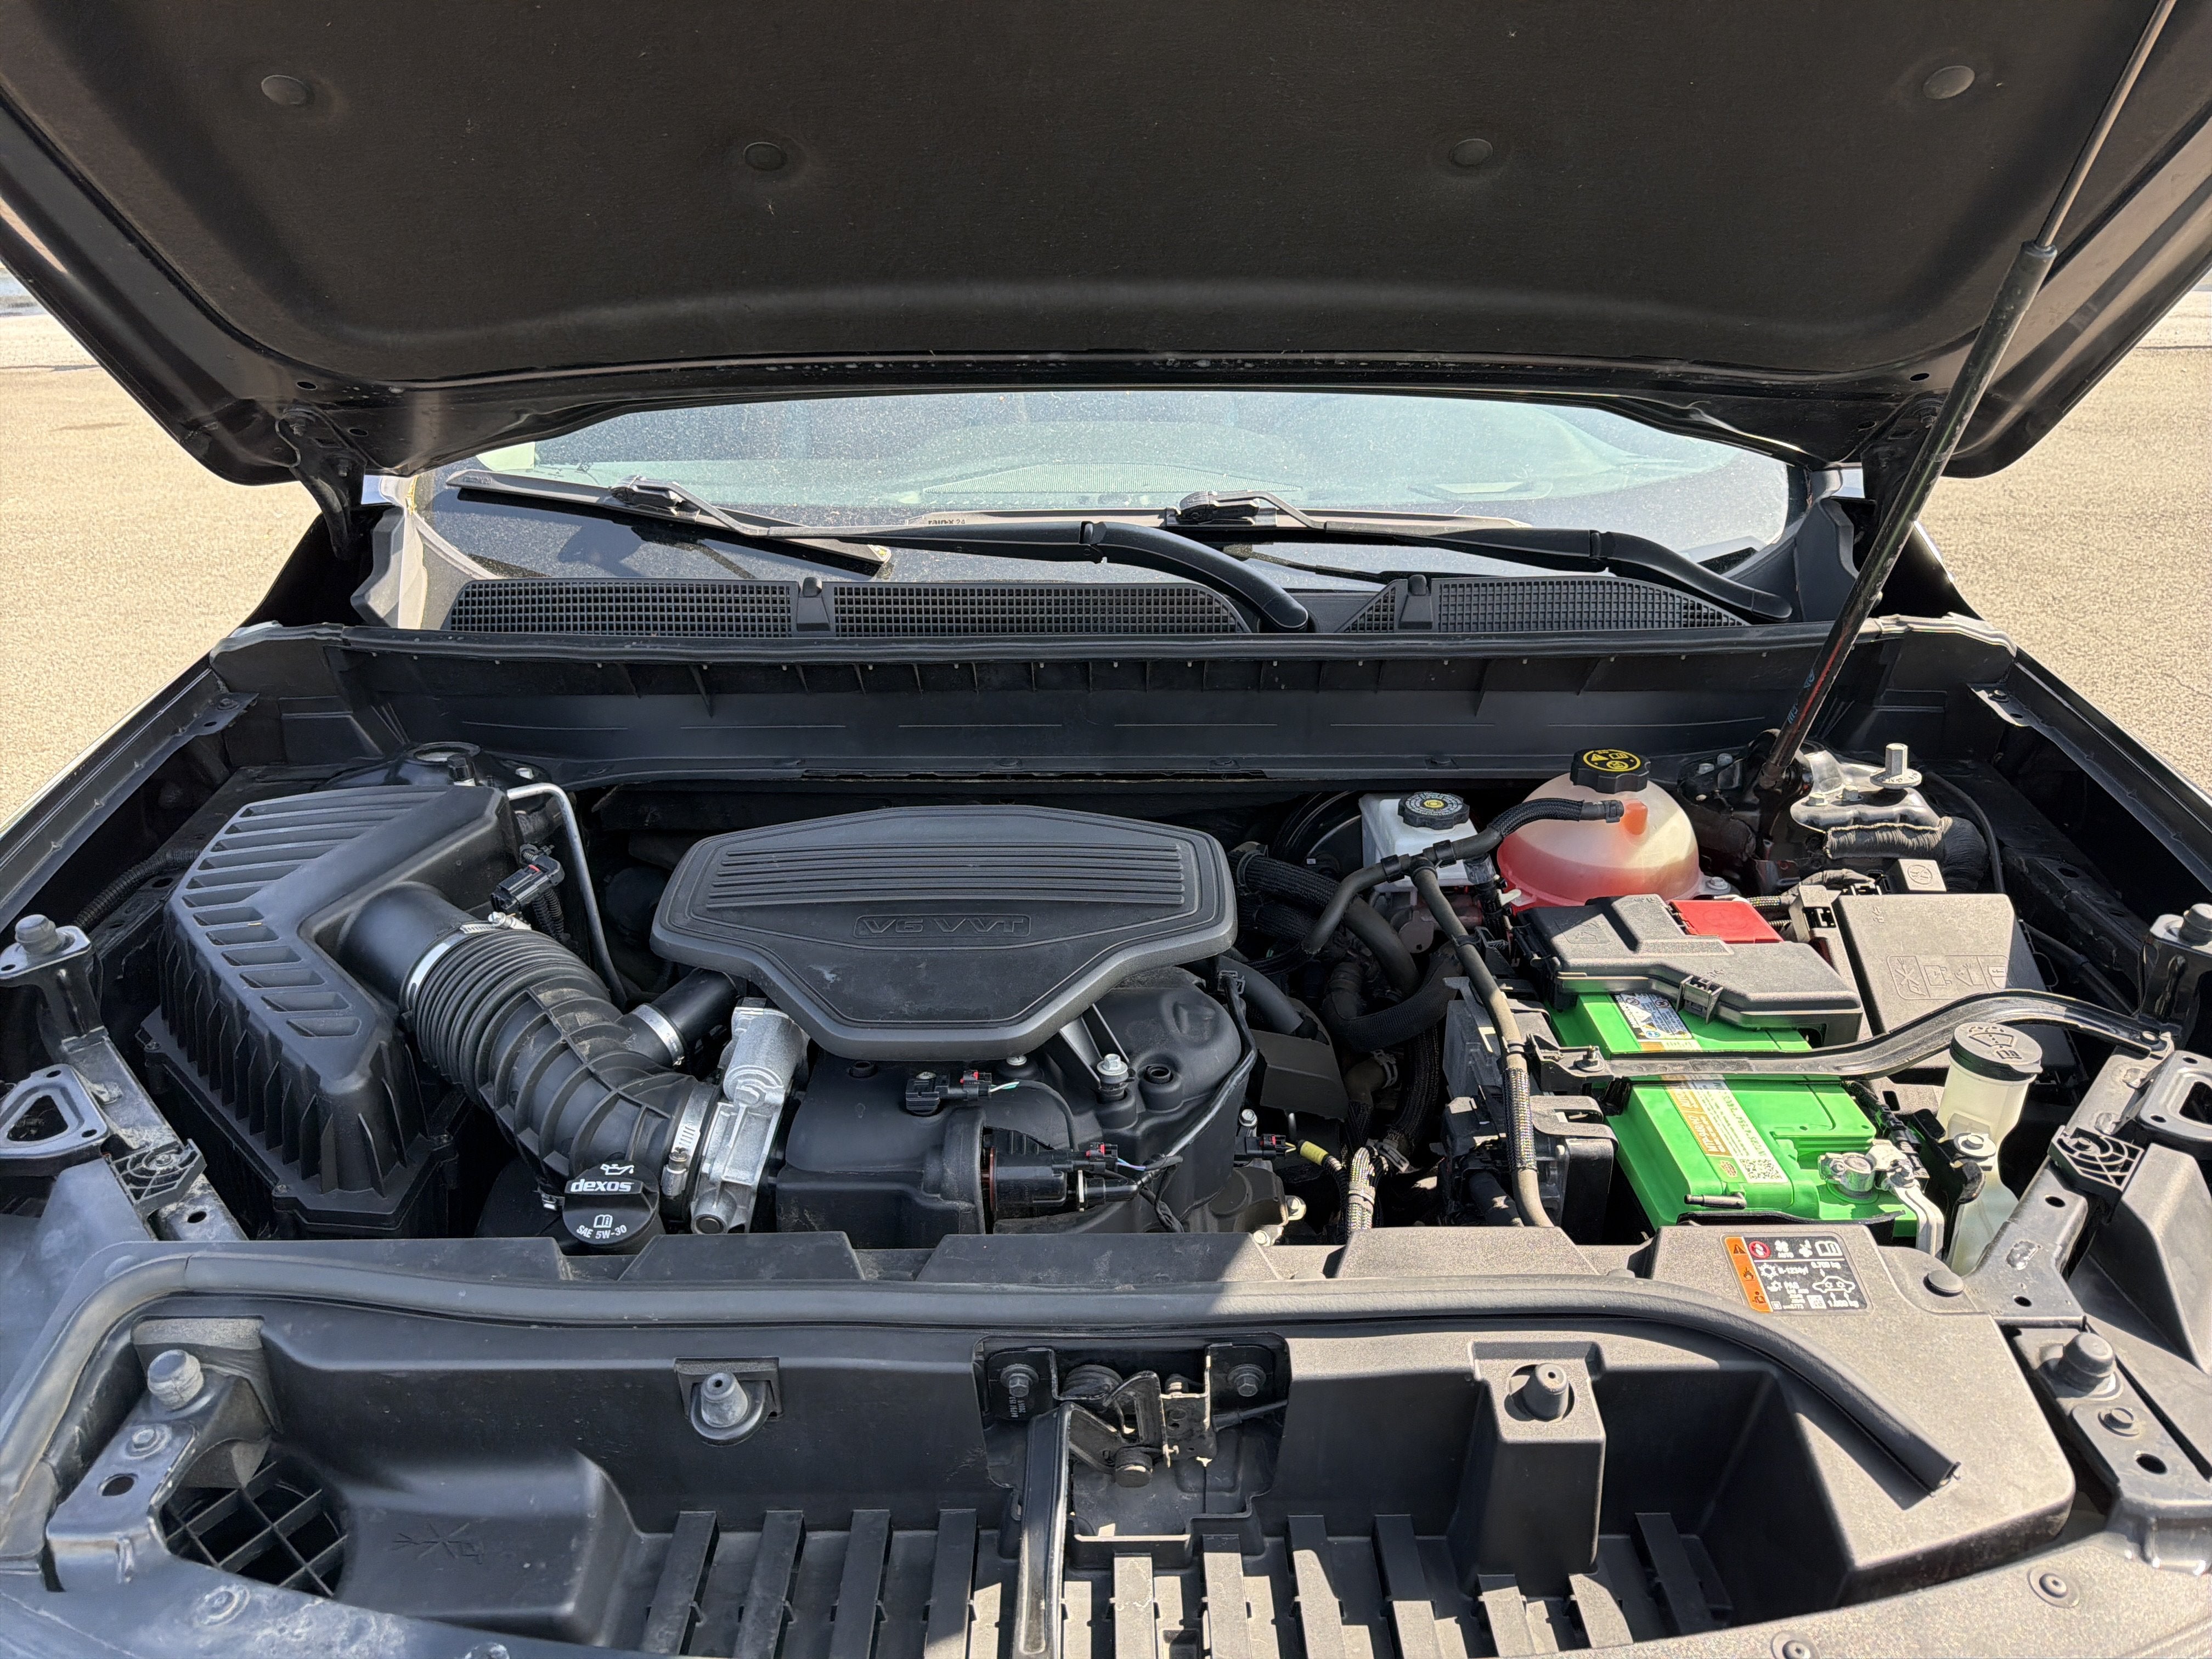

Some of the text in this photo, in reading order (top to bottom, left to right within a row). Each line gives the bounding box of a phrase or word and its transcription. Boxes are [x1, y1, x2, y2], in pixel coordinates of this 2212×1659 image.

[864, 918, 1024, 933] V6 VVT
[571, 1179, 634, 1192] dexos
[576, 1224, 627, 1239] SAE 5W-30
